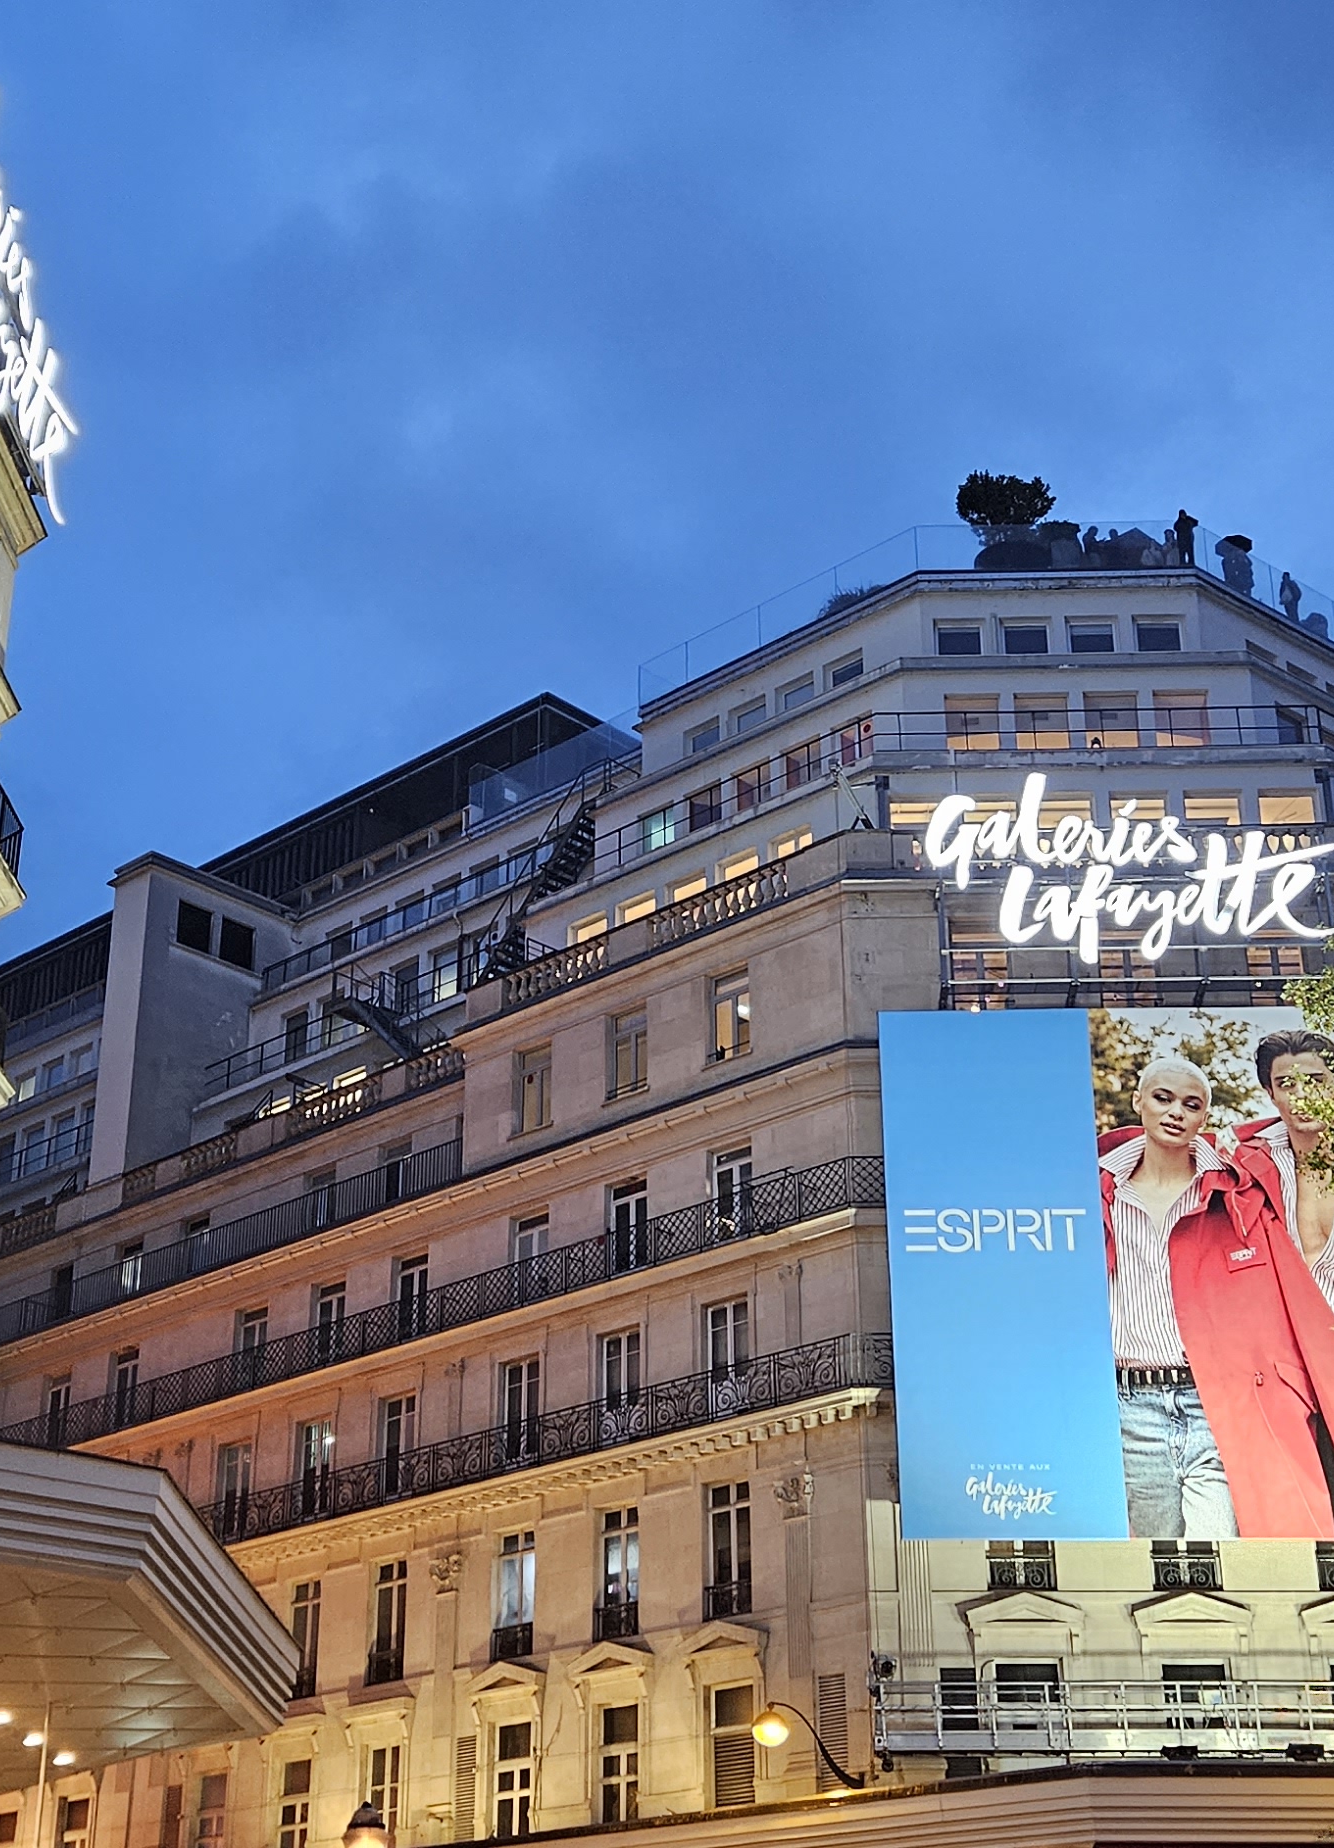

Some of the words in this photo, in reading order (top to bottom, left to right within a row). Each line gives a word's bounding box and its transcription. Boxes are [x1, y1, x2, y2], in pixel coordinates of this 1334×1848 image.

[924, 771, 1198, 891] Galeries
[904, 1207, 1087, 1253] ESPRIT
[970, 1463, 985, 1471] EN
[988, 1463, 1025, 1471] VENTE
[1029, 1463, 1051, 1471] AUX
[965, 1471, 1028, 1501] Galeries
[982, 1486, 1058, 1521] Lafayette
